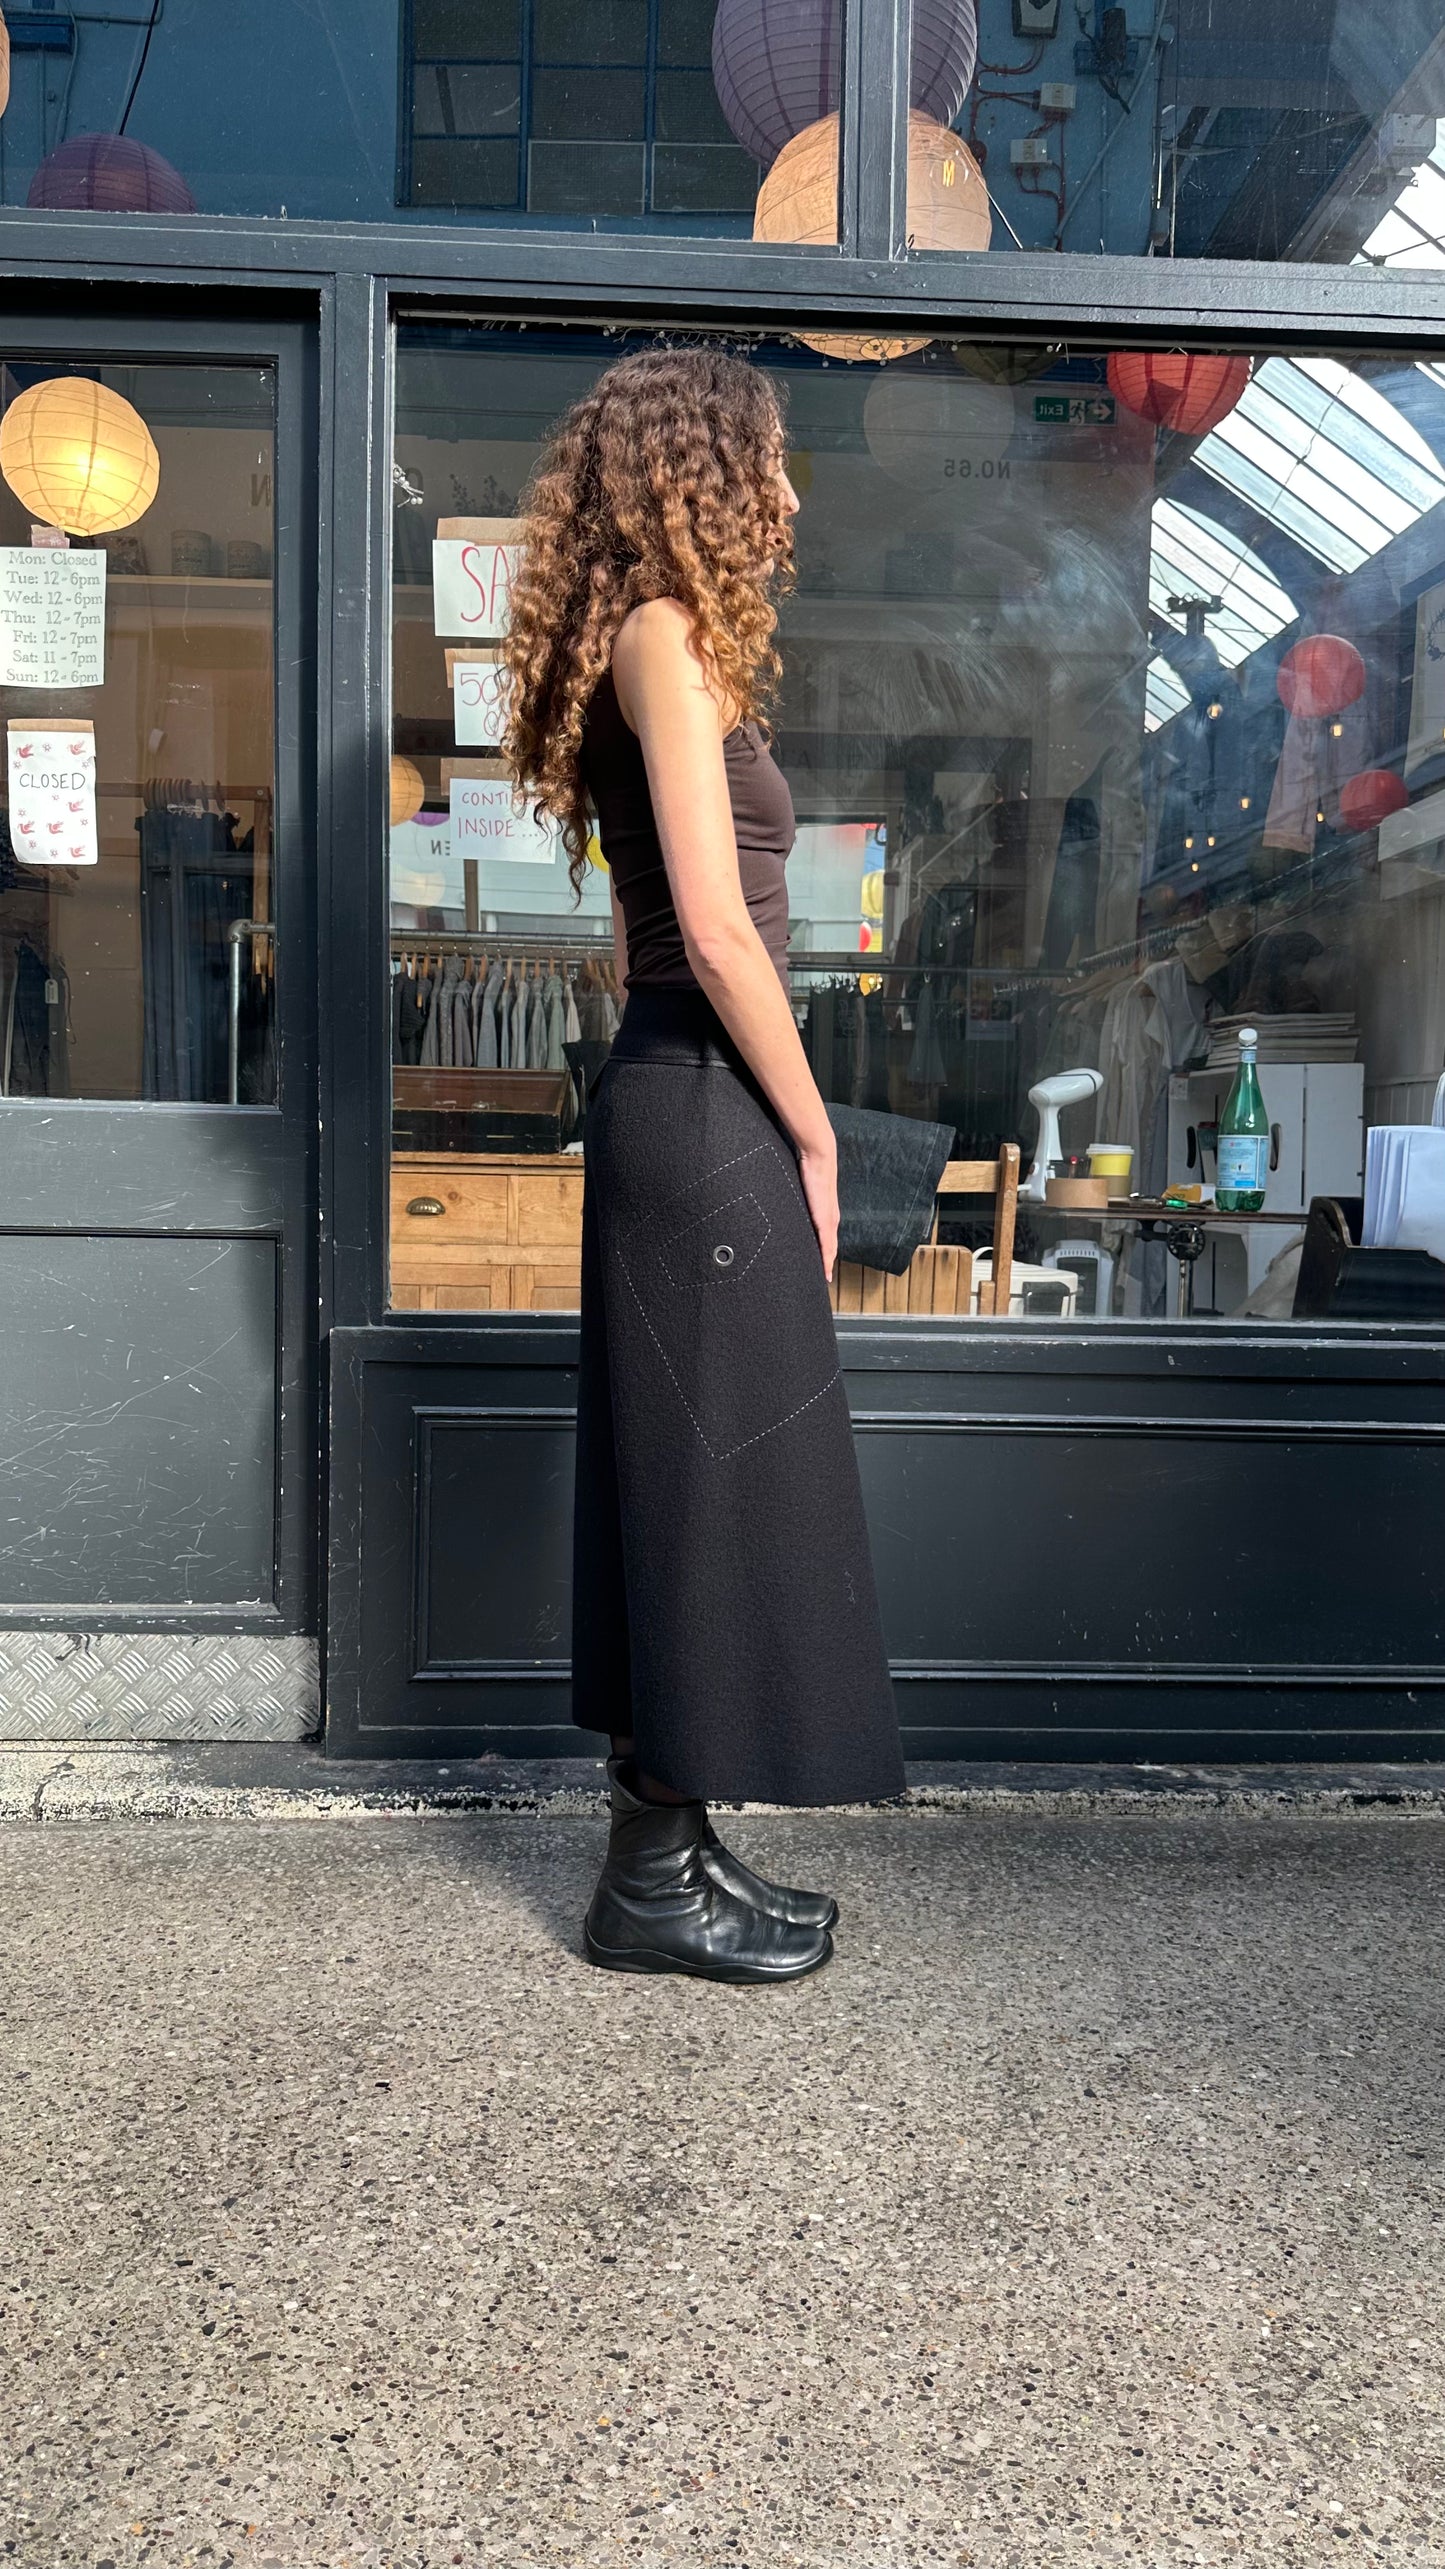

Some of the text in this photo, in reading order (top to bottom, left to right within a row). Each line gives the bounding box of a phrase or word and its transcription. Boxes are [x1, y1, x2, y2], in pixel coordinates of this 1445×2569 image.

[9, 551, 97, 566] Mon: Closed
[6, 571, 39, 584] Tue:
[3, 590, 43, 605] Wed:
[1, 610, 36, 624] Thu:
[13, 630, 37, 643] Fri:
[13, 649, 38, 663] Sat:
[6, 668, 38, 682] Sun:
[20, 772, 86, 790] CLOSED
